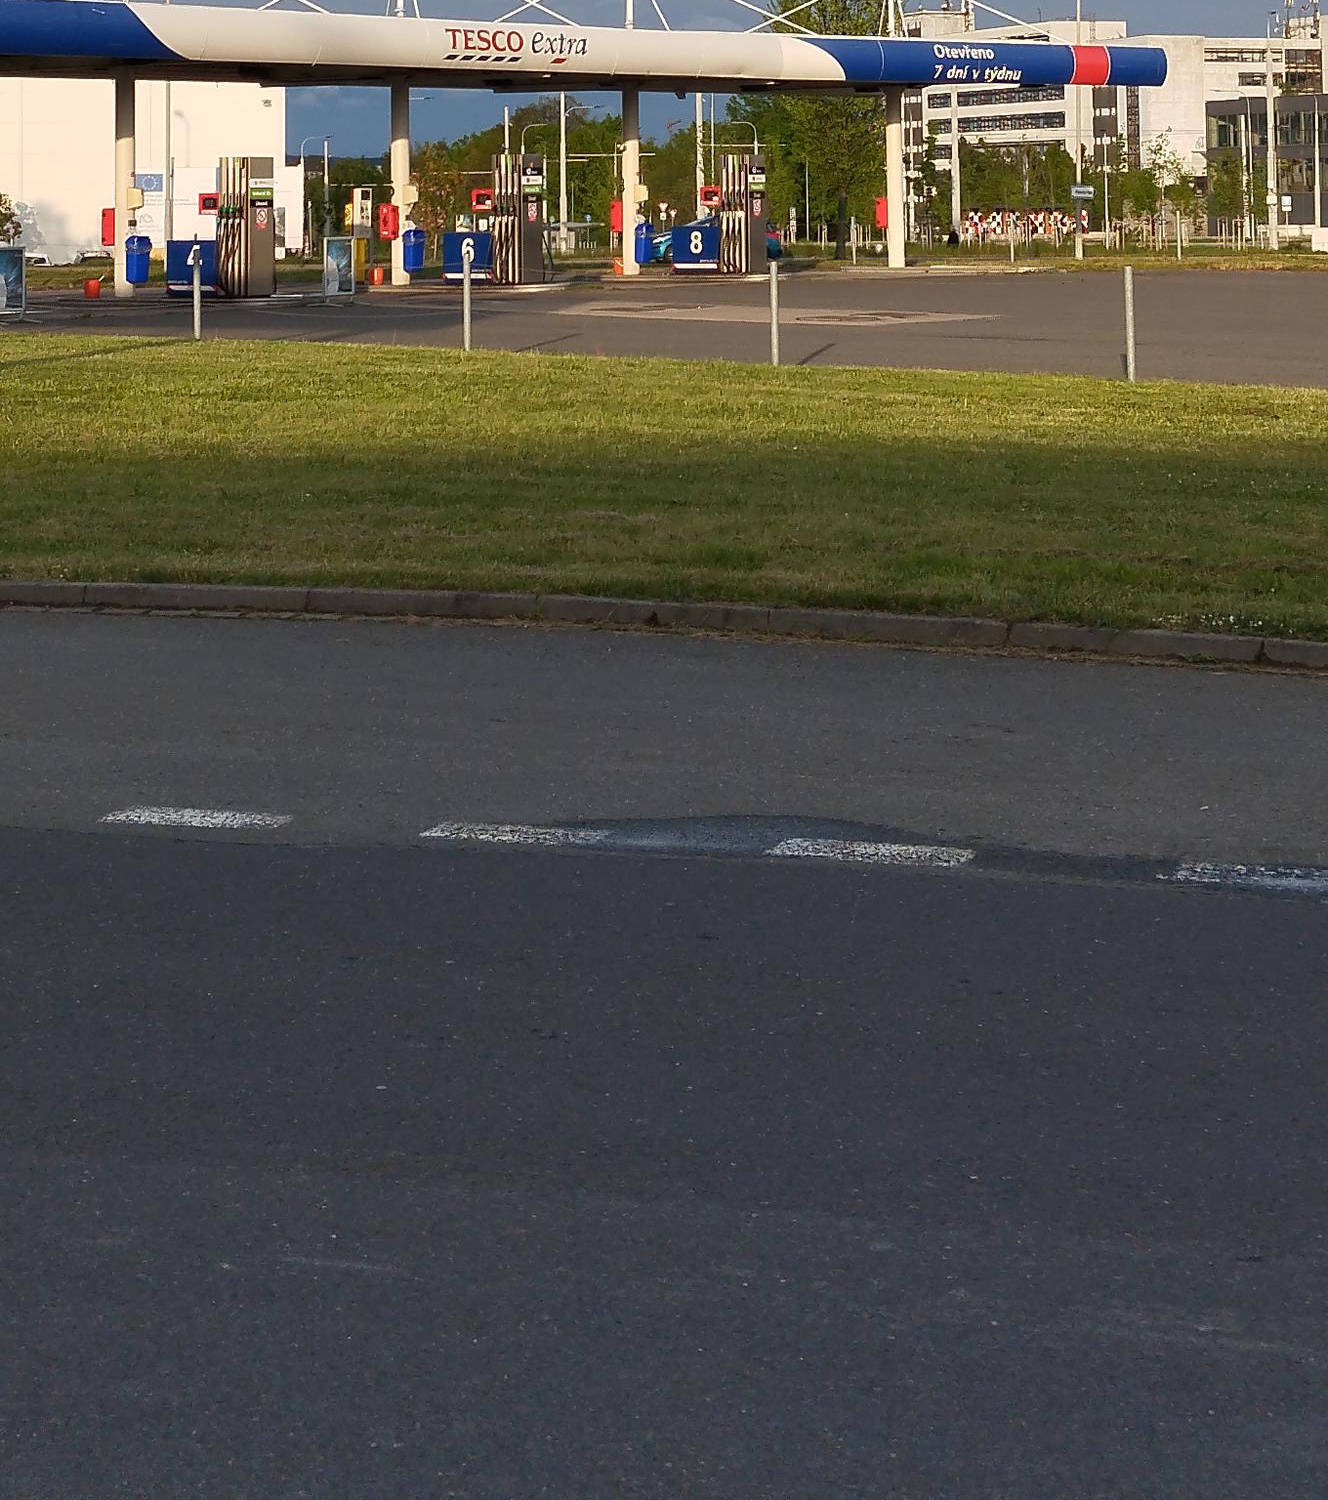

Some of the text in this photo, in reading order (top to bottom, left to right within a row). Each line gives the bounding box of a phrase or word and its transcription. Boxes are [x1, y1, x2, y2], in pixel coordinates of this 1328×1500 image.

[445, 28, 588, 56] TESCO extra
[933, 44, 995, 60] Otevřeno
[934, 64, 1022, 83] 7 dní v týdnu
[461, 237, 475, 263] 6
[690, 231, 703, 254] 8
